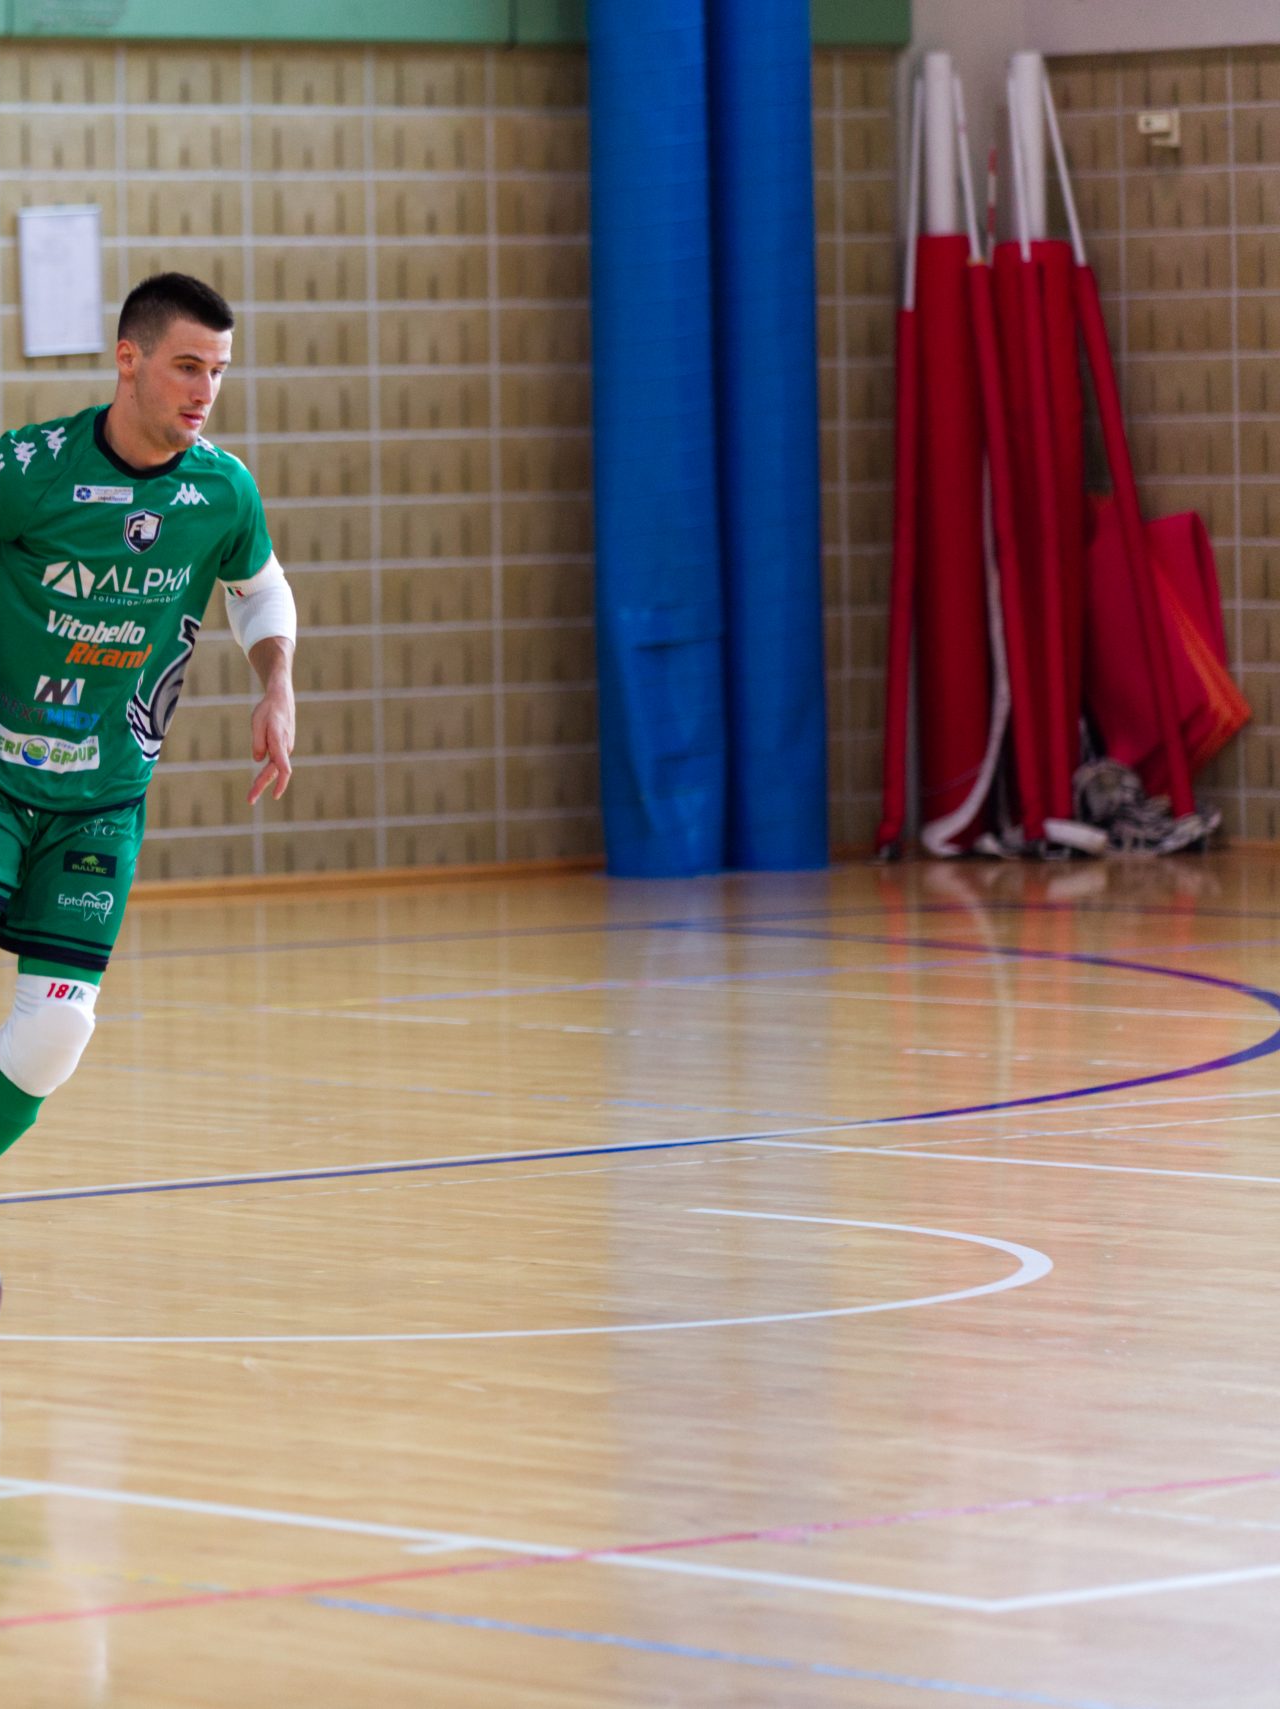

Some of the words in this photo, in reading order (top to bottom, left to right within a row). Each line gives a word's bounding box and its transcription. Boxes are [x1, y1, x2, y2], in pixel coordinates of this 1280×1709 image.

[95, 563, 192, 595] ALPHA
[46, 609, 146, 645] Vitobello
[65, 642, 152, 669] Ricami
[58, 893, 111, 911] Eptamed
